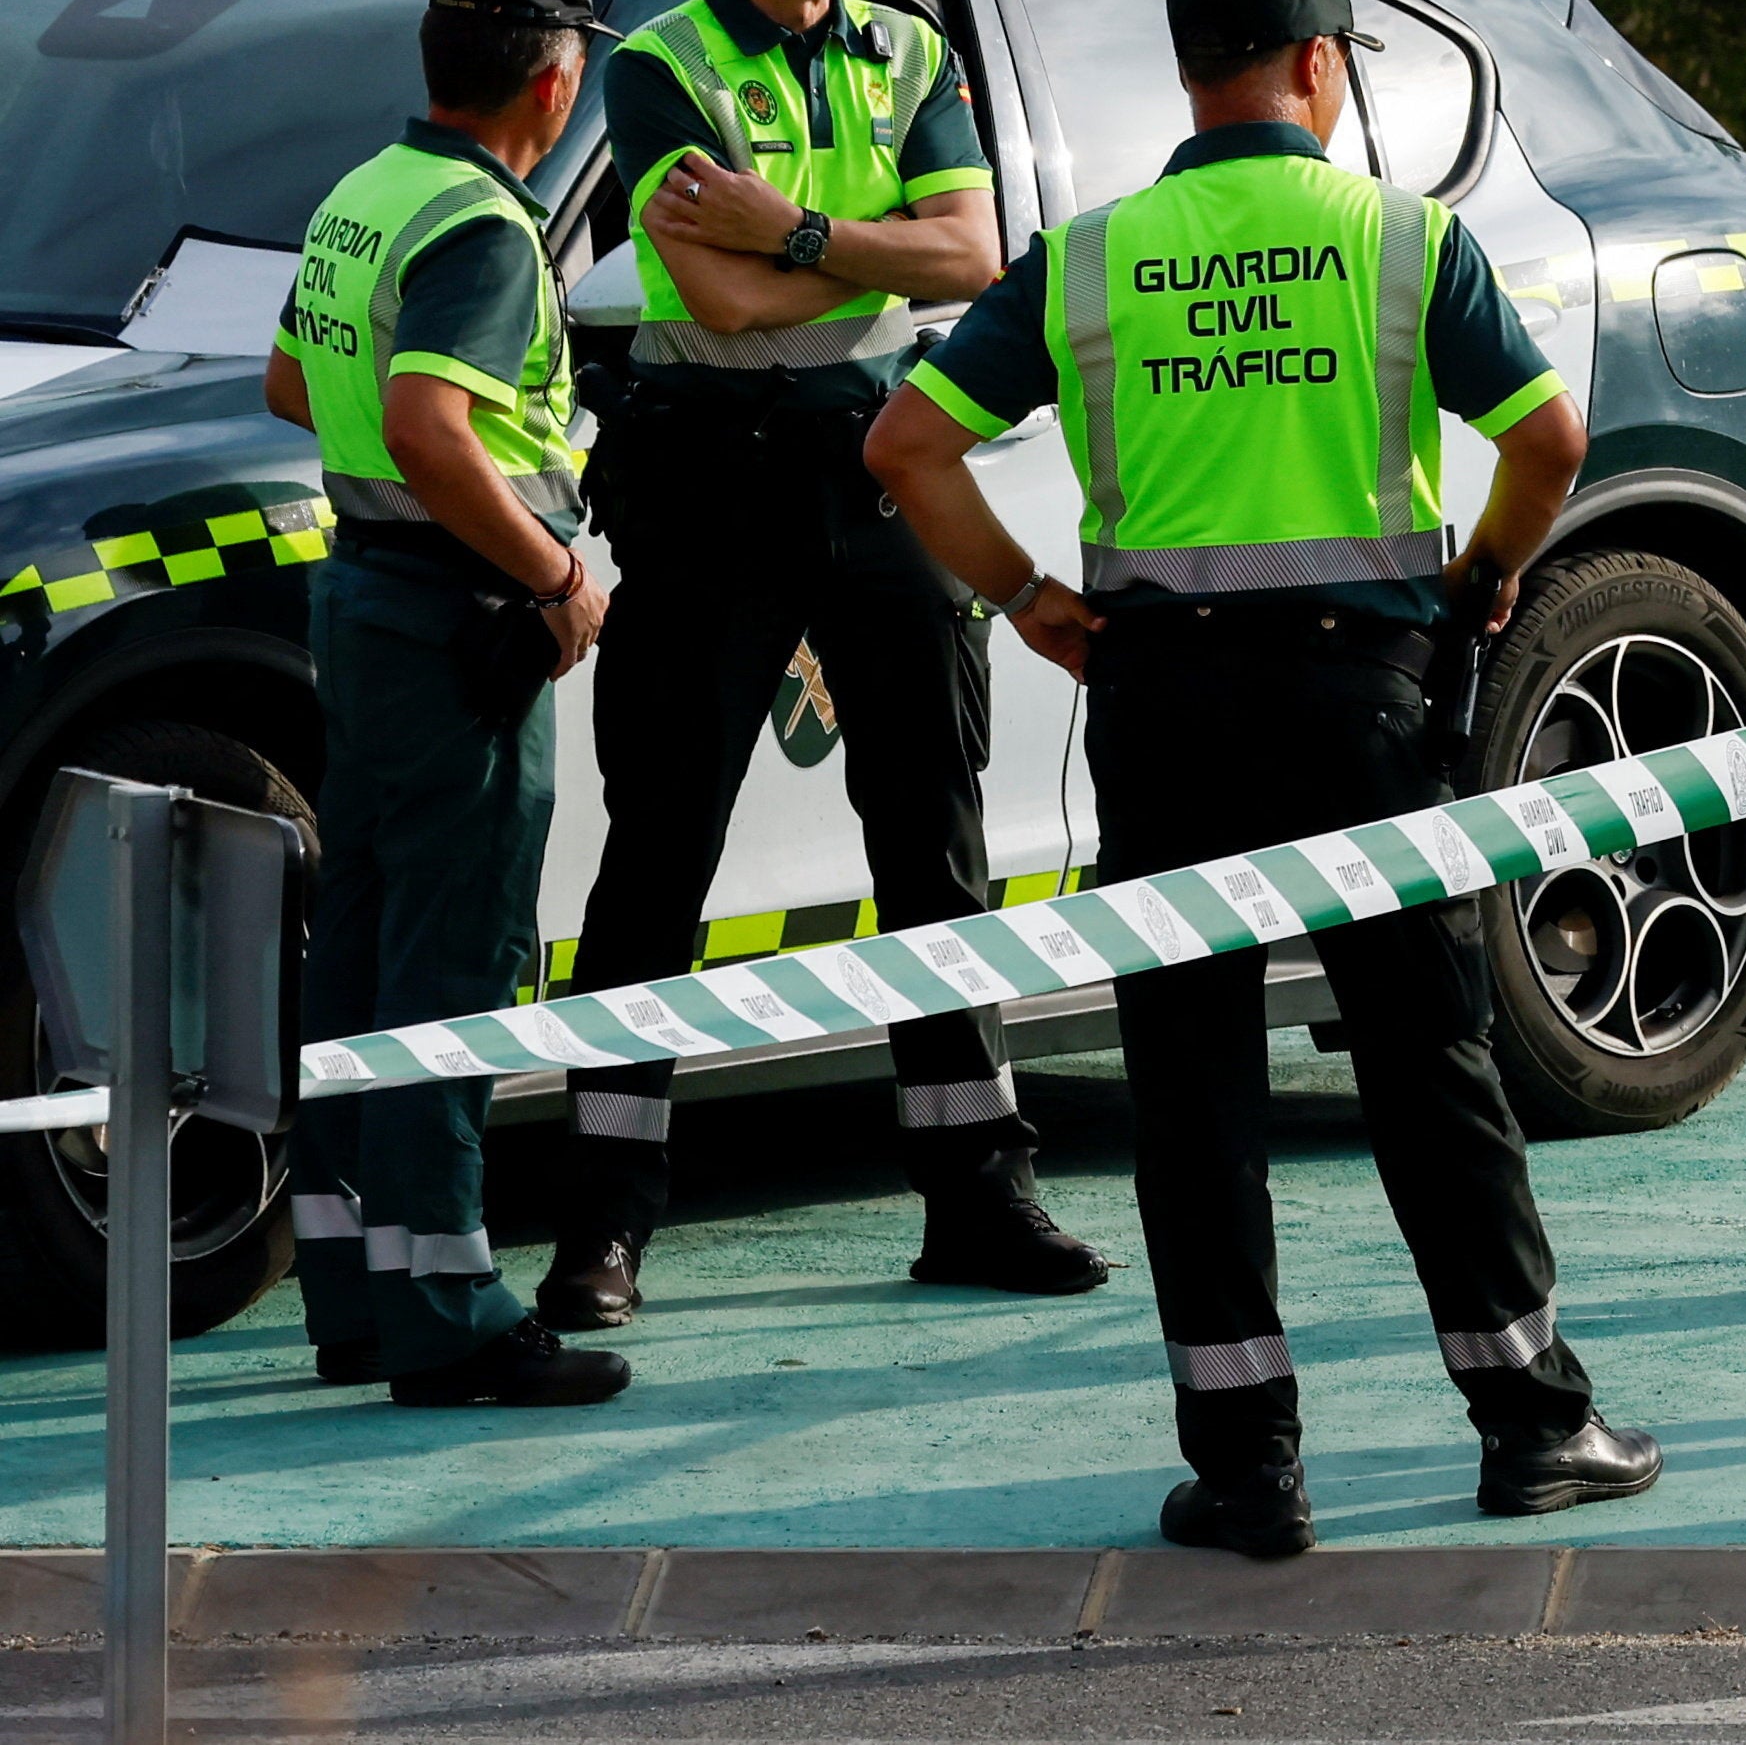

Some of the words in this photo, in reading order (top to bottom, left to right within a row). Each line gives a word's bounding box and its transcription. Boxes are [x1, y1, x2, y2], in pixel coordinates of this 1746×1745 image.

[303, 255, 337, 300] CIVIL
[1133, 245, 1348, 293] GUARDIA
[1187, 294, 1292, 337] CIVIL
[1142, 346, 1337, 394] TRÁFICO
[1518, 797, 1558, 829] GUARDIA
[1628, 786, 1664, 819] TRAFICO
[1545, 827, 1567, 856] CIVIL
[1224, 869, 1265, 901] GUARDIA
[1336, 860, 1374, 892] TRAFICO
